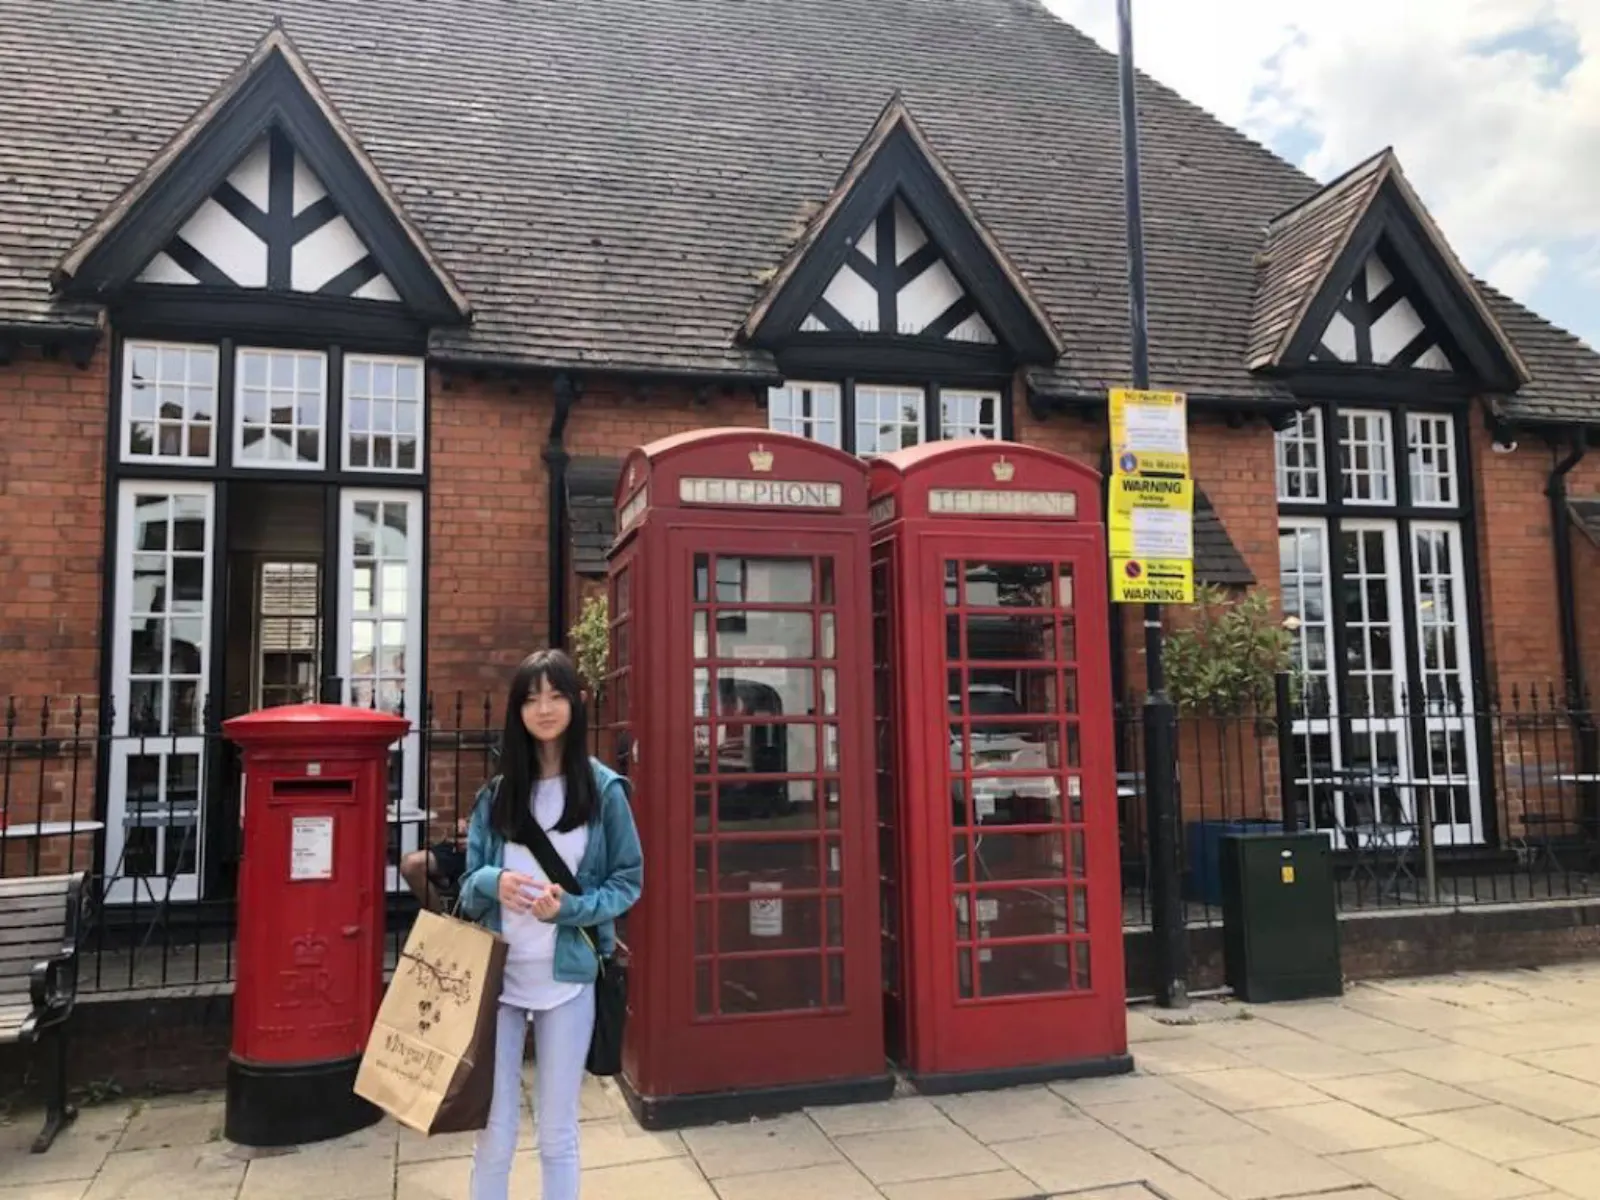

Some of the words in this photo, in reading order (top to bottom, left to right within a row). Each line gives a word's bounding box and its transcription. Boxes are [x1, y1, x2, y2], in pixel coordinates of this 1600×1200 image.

[684, 480, 837, 506] TELEPHONE
[1122, 480, 1182, 494] WARNING
[934, 491, 1073, 514] TELEPHONE
[1122, 588, 1185, 601] WARNING
